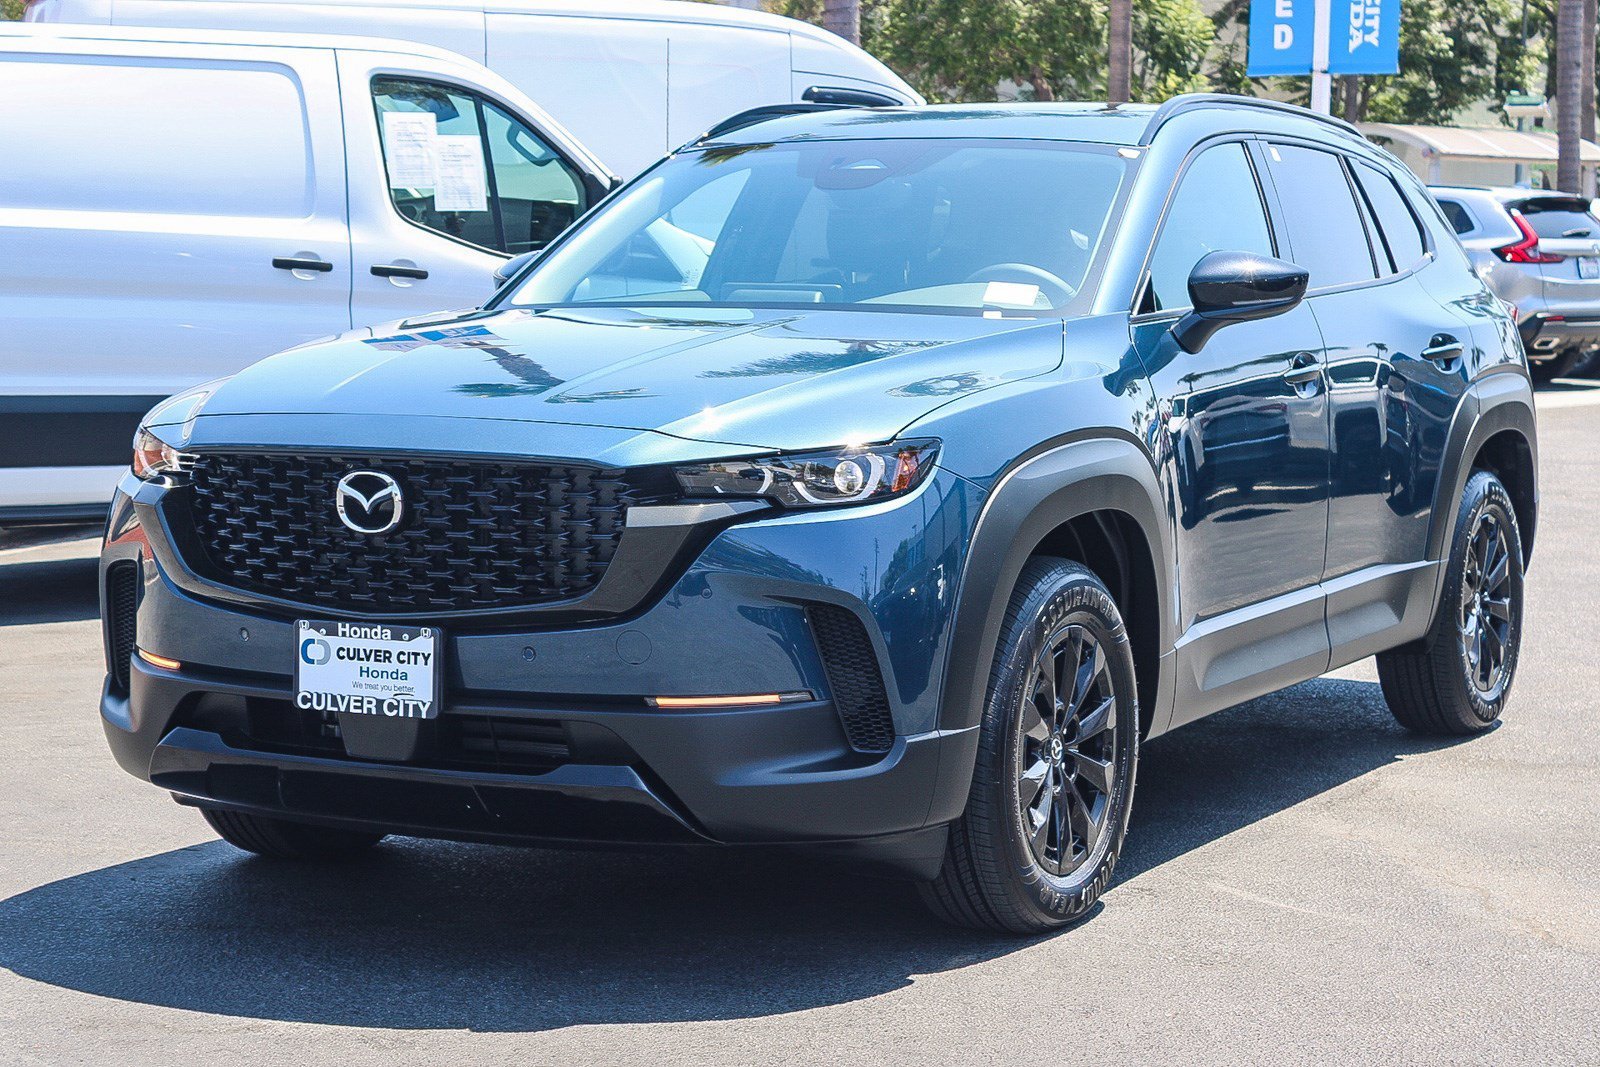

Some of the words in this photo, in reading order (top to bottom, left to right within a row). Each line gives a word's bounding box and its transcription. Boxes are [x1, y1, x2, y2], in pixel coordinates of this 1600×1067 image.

[1349, 0, 1364, 53] DA
[337, 622, 392, 640] Honda
[336, 646, 392, 664] CULVER
[396, 651, 432, 666] CITY
[360, 666, 408, 681] Honda
[352, 681, 363, 689] We
[364, 682, 379, 690] treat
[380, 684, 392, 692] you
[297, 691, 377, 715] CULVER
[383, 698, 432, 719] CITY
